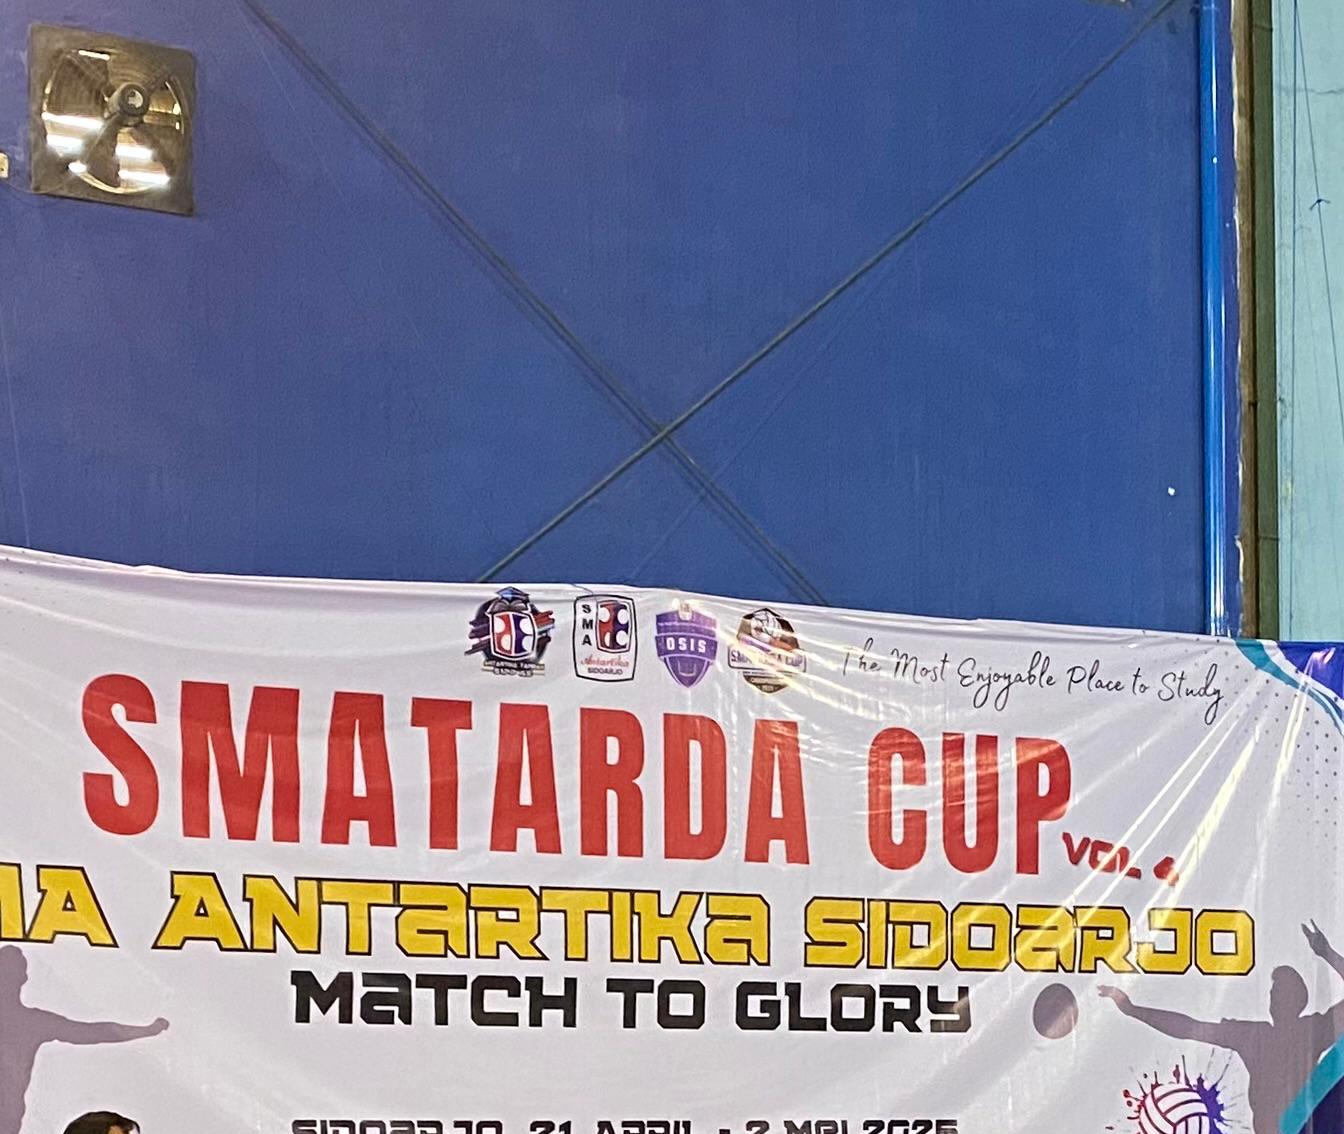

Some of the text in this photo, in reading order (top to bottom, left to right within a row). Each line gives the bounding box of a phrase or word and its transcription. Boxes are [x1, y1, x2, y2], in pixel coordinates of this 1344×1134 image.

[666, 636, 706, 653] OSIS
[842, 637, 1225, 726] The Most Enjoyable Place to Study
[82, 673, 810, 865] SMATARDA
[867, 727, 1072, 876] CUP
[606, 978, 707, 1030] TO
[735, 981, 973, 1033] GLORY
